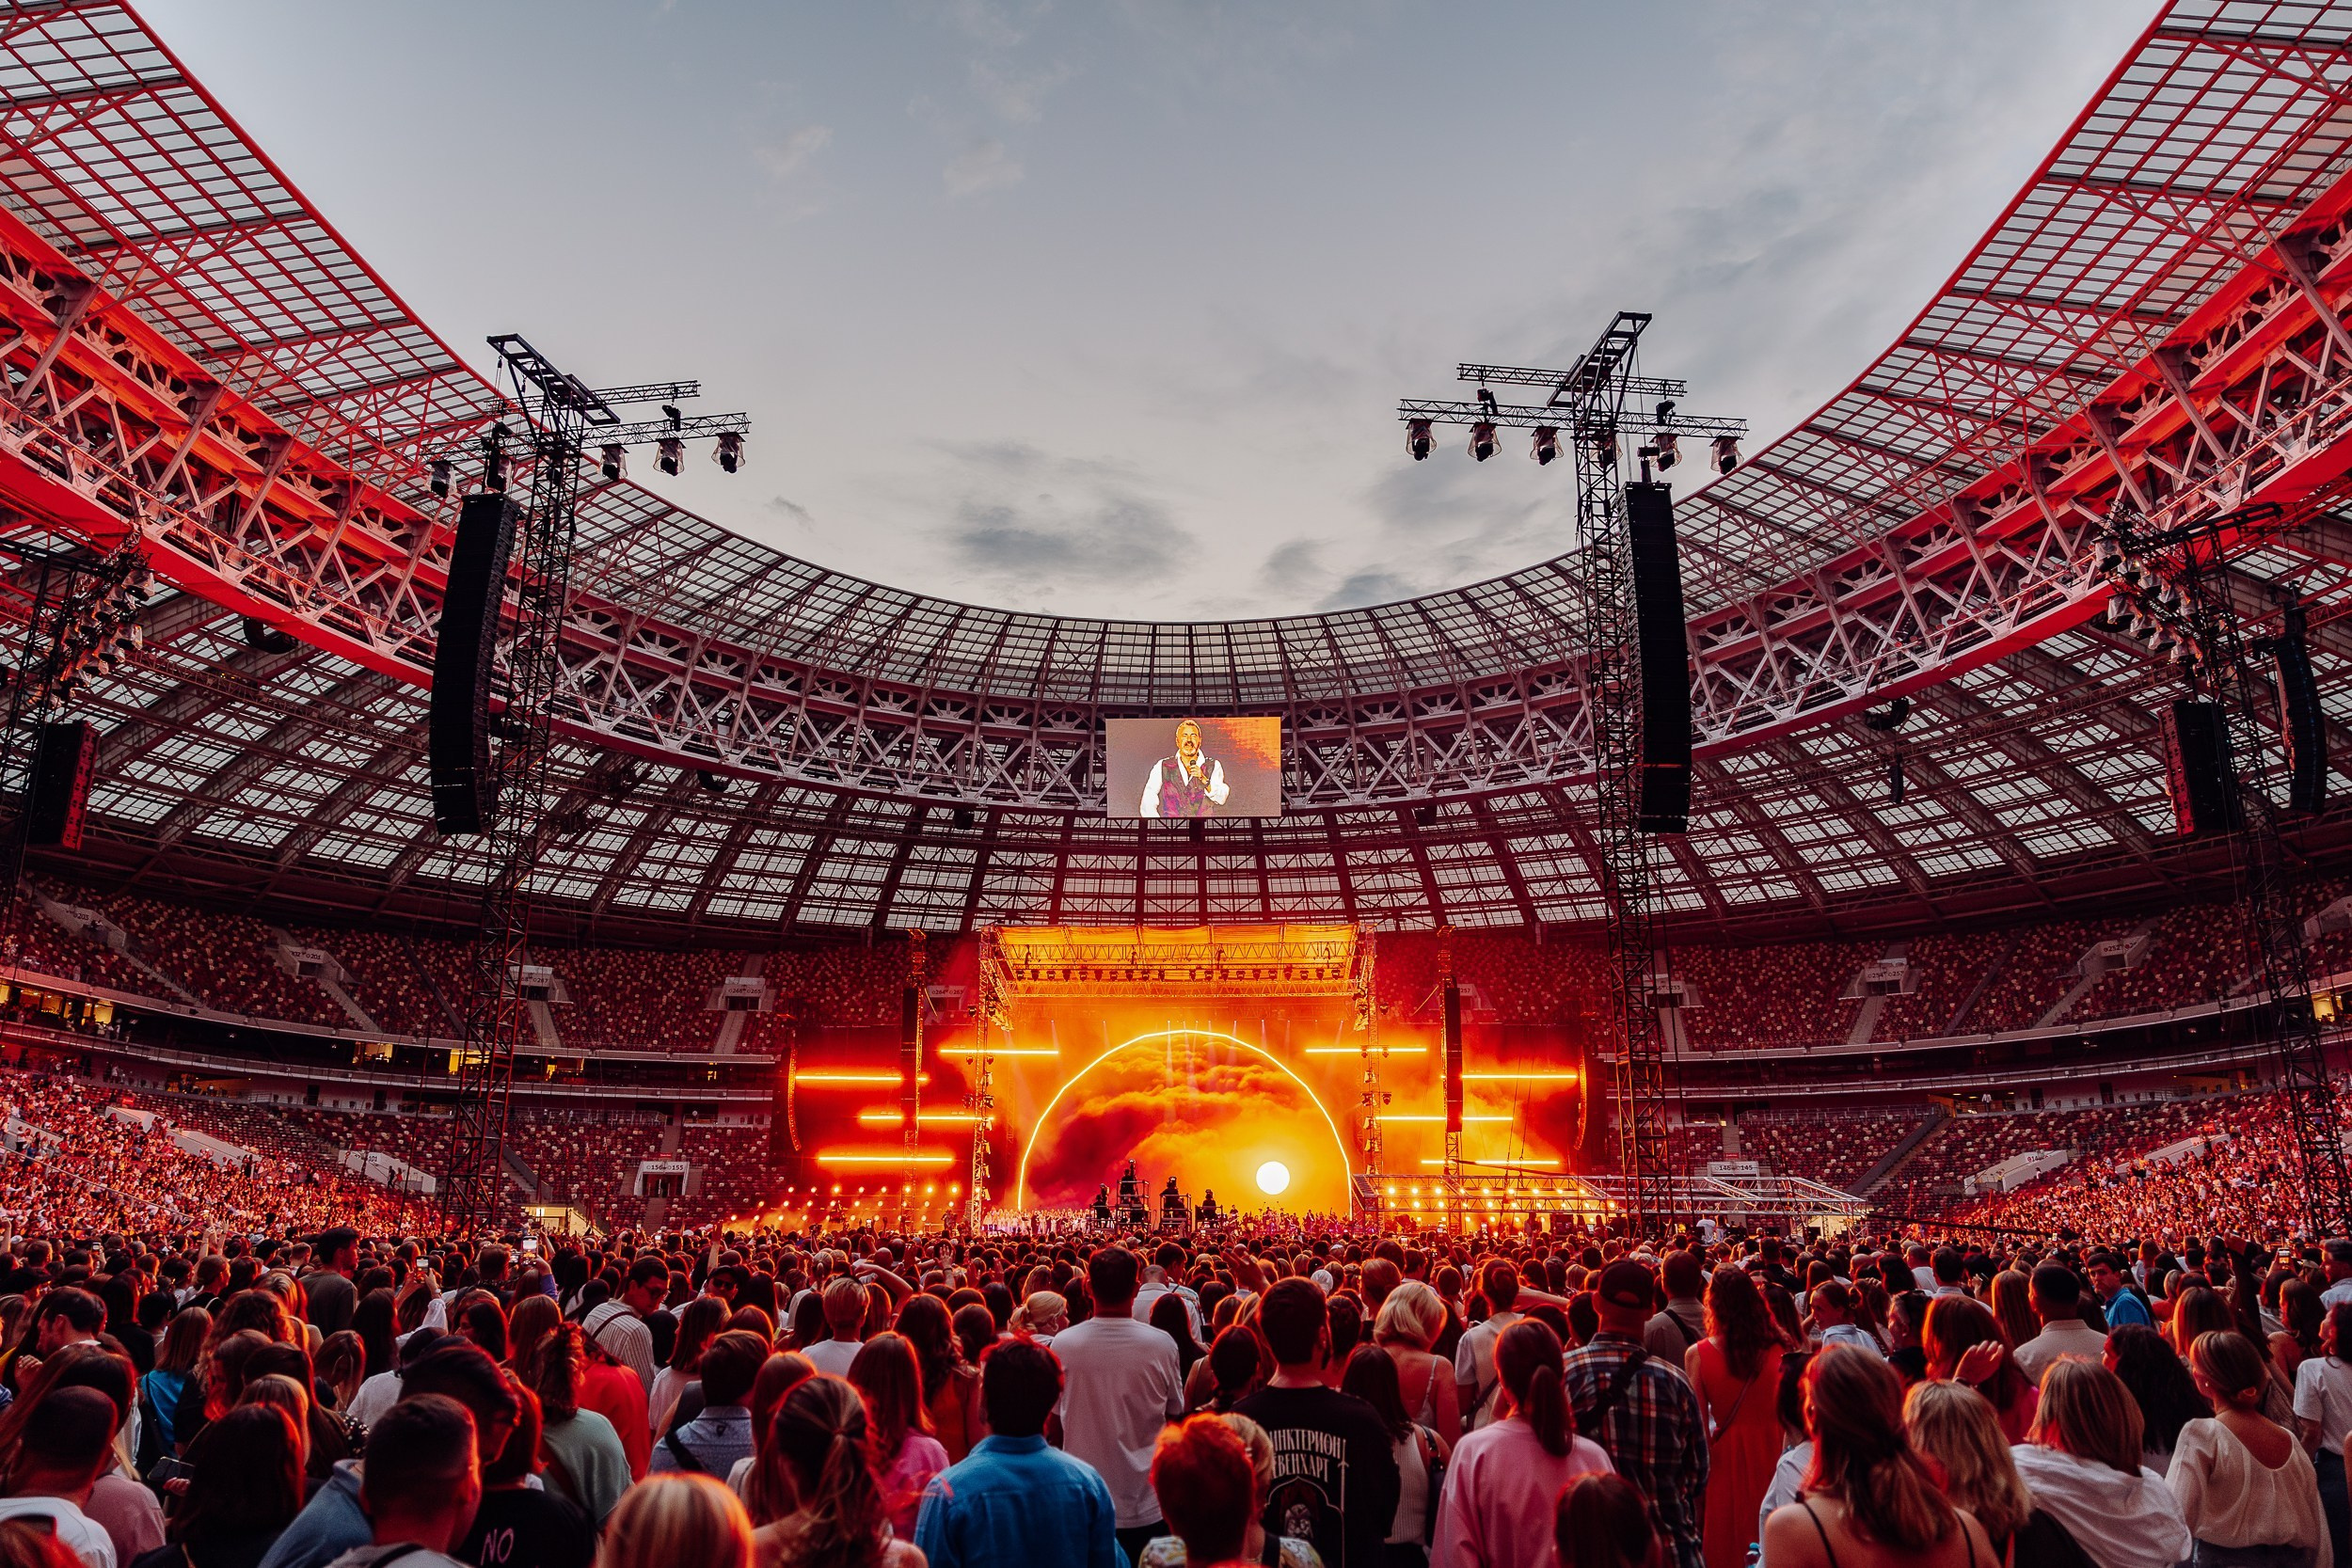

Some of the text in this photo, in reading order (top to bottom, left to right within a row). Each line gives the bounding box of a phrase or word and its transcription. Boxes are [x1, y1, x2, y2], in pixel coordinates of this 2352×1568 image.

[1269, 1429, 1341, 1460] ИНКТЕРИОН
[1272, 1453, 1329, 1483] ЕВЕНХАРТ
[480, 1528, 515, 1566] NO
